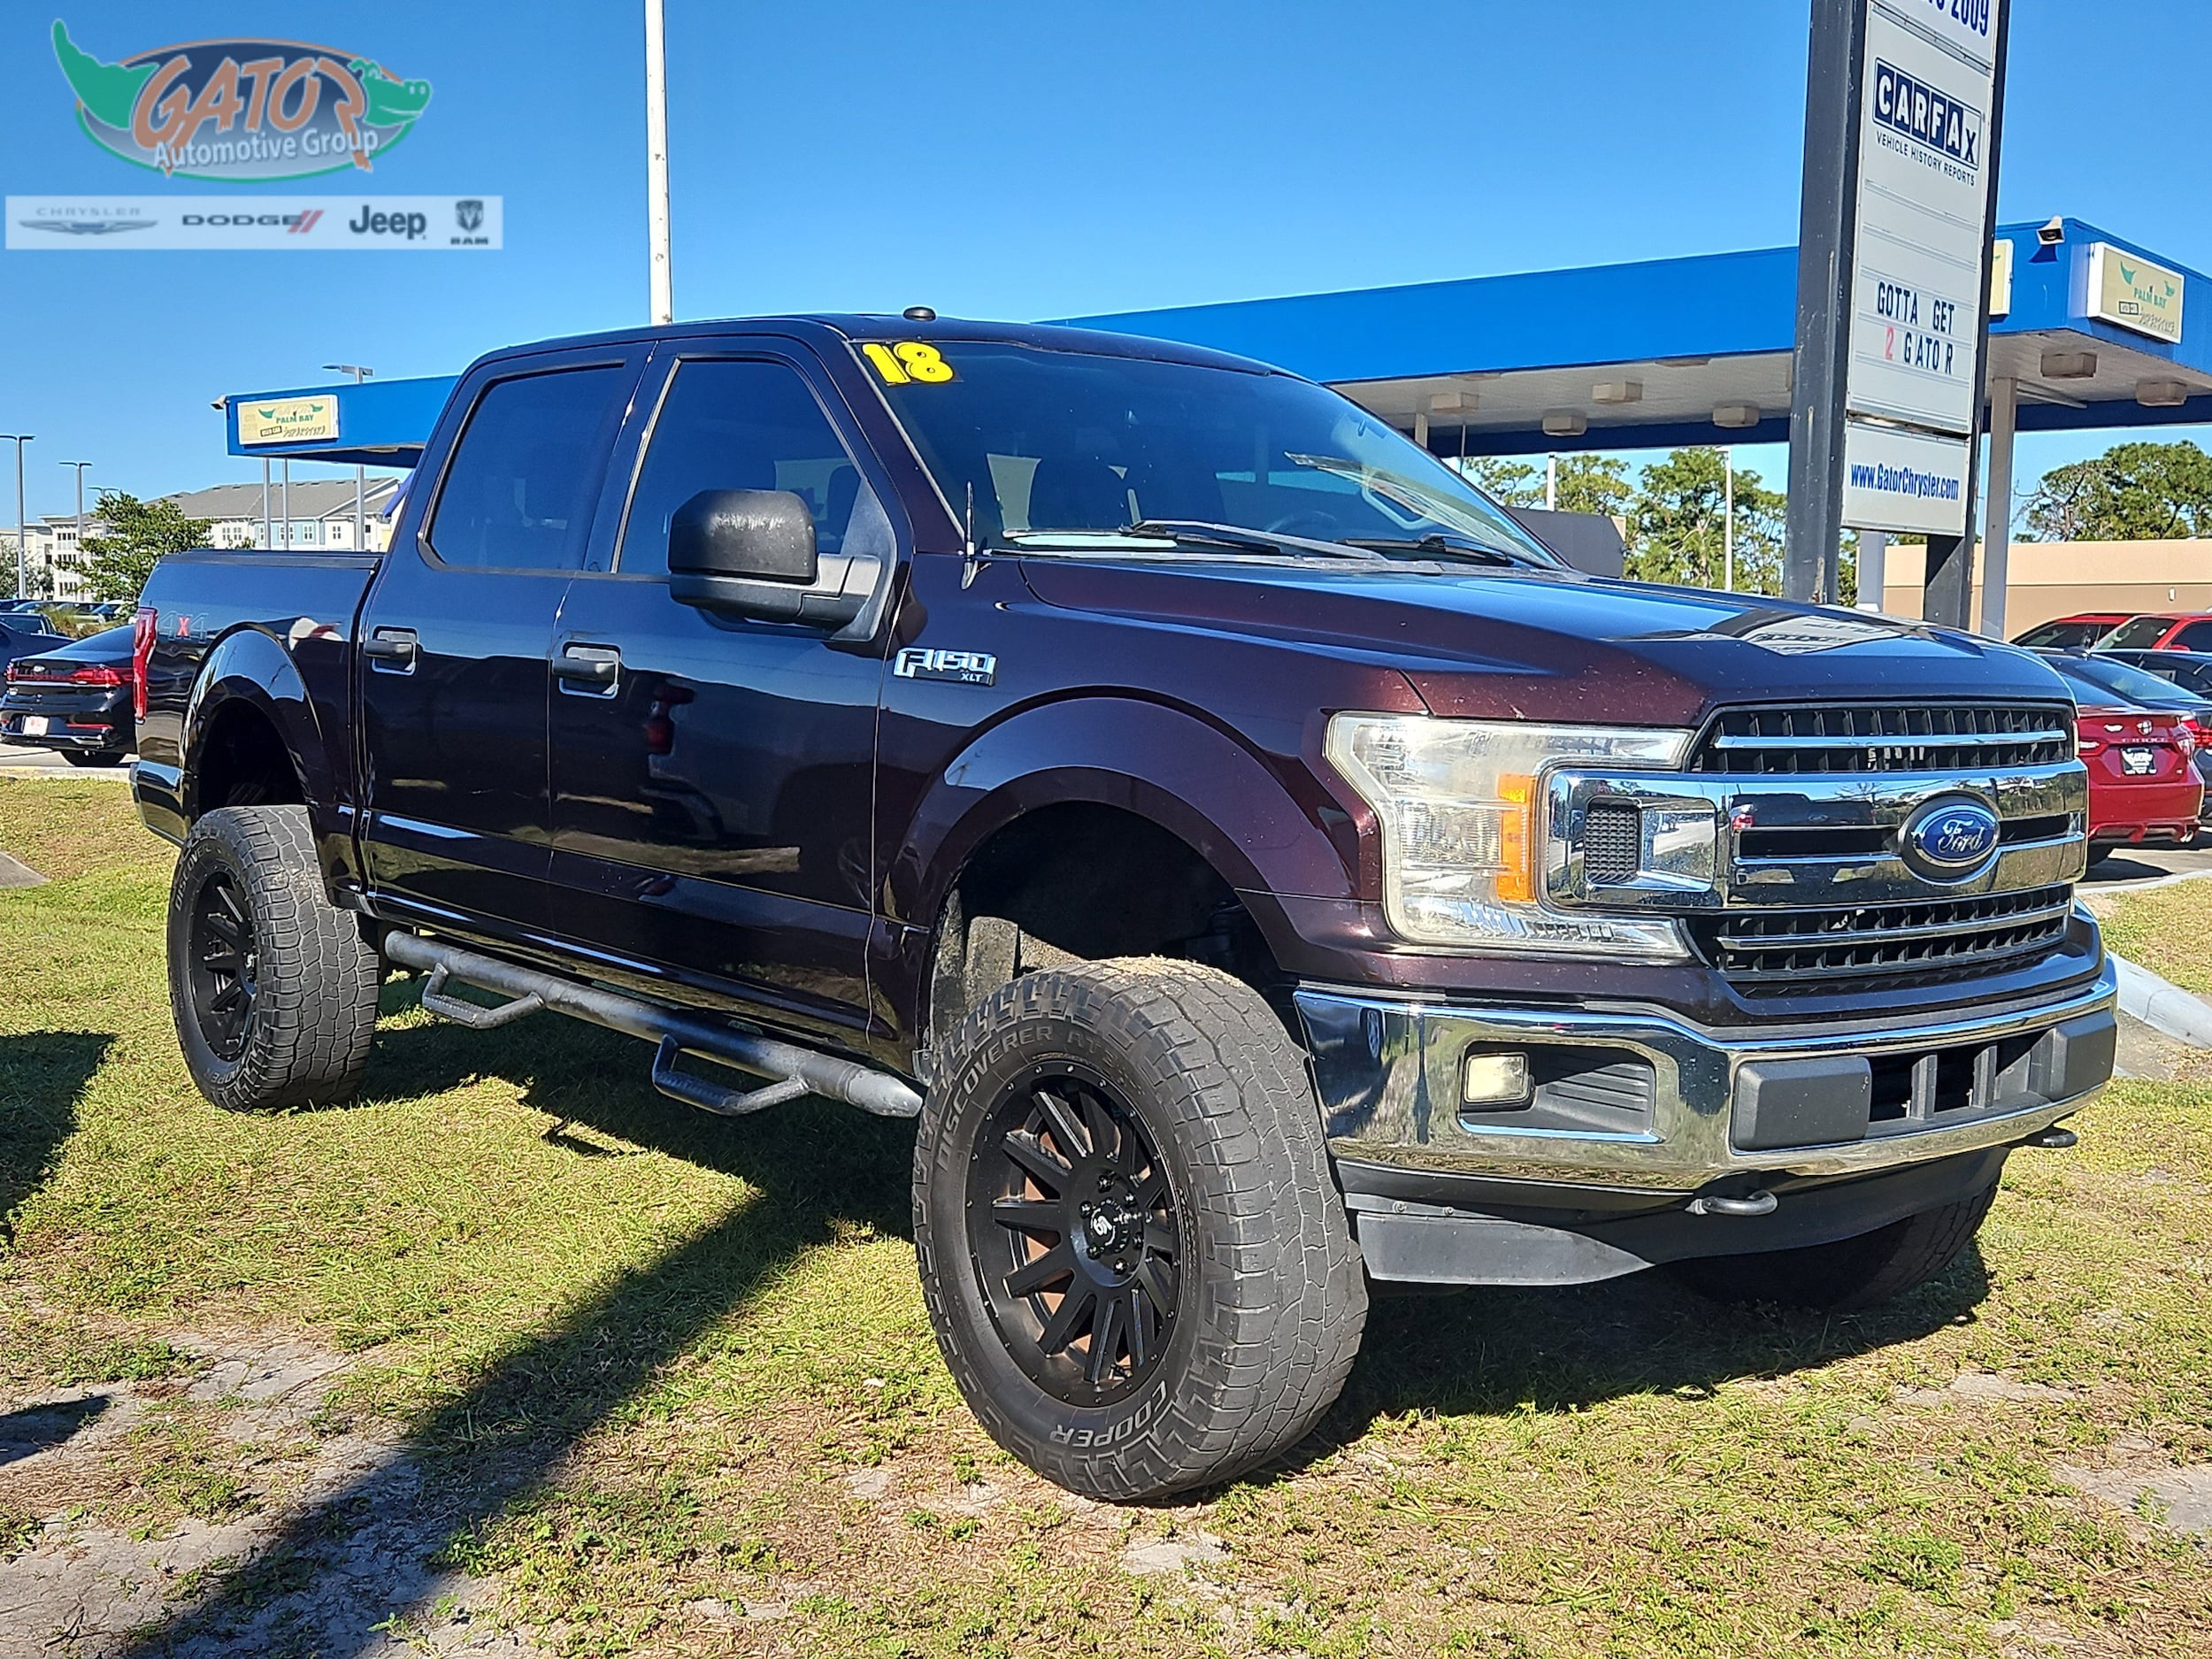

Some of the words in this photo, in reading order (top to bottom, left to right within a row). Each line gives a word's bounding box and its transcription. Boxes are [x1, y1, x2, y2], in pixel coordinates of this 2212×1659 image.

[1877, 73, 1977, 165] CARFAX
[1877, 131, 1909, 157] VEHICLE
[1911, 147, 1941, 171] HISTORY
[1944, 163, 1975, 187] REPORTS
[1878, 281, 1918, 326] GOTTA
[1933, 299, 1955, 334] GET
[862, 342, 954, 384] 18
[1886, 326, 1894, 360] 2
[1904, 331, 1954, 375] GATOR
[276, 413, 297, 424] PALM
[299, 413, 314, 422] BAY
[1851, 463, 1959, 501] www.GatorChrysler.com
[961, 672, 983, 682] XLT
[1938, 819, 1985, 853] Ford
[936, 1024, 1055, 1171] DISCOVERER
[1049, 1380, 1167, 1448] COOPER
